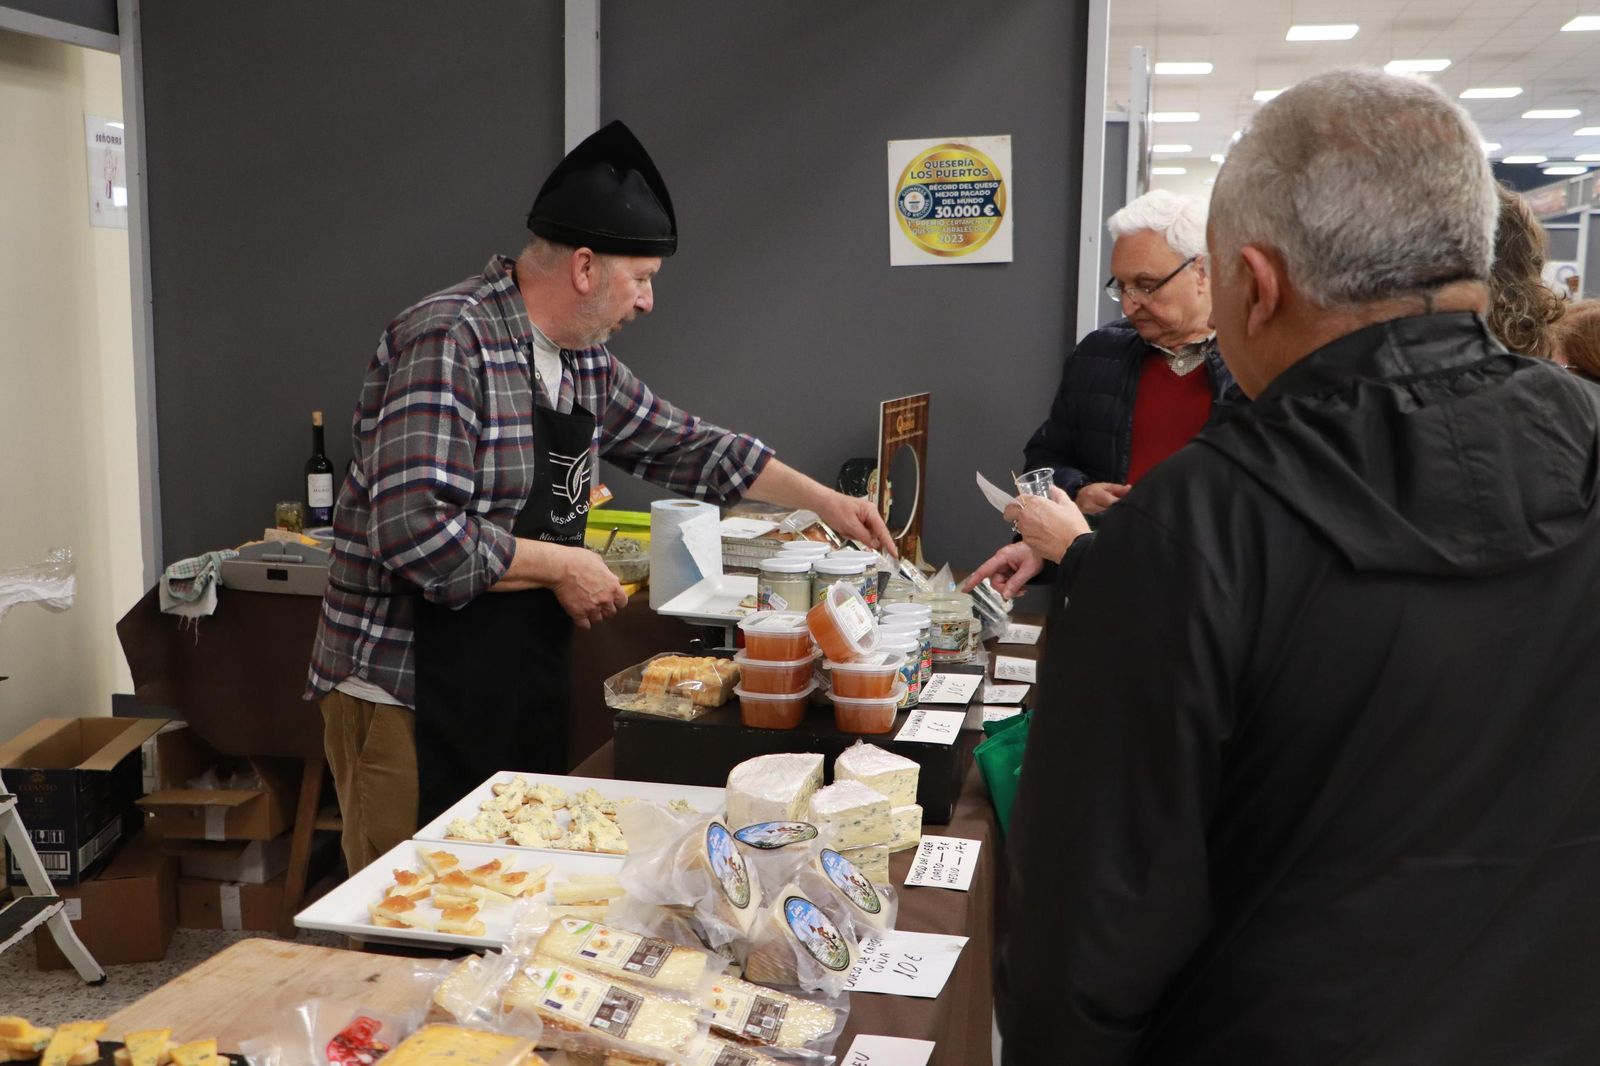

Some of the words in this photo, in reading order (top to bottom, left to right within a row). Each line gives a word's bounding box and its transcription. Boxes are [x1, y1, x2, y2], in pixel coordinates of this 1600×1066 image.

[924, 159, 975, 169] QUESERÍA
[910, 171, 932, 179] LOS
[936, 168, 989, 178] PUERTOS
[935, 205, 981, 218] 30.000
[983, 204, 995, 216] €
[939, 234, 965, 243] 2023
[869, 952, 891, 974] CUÑA
